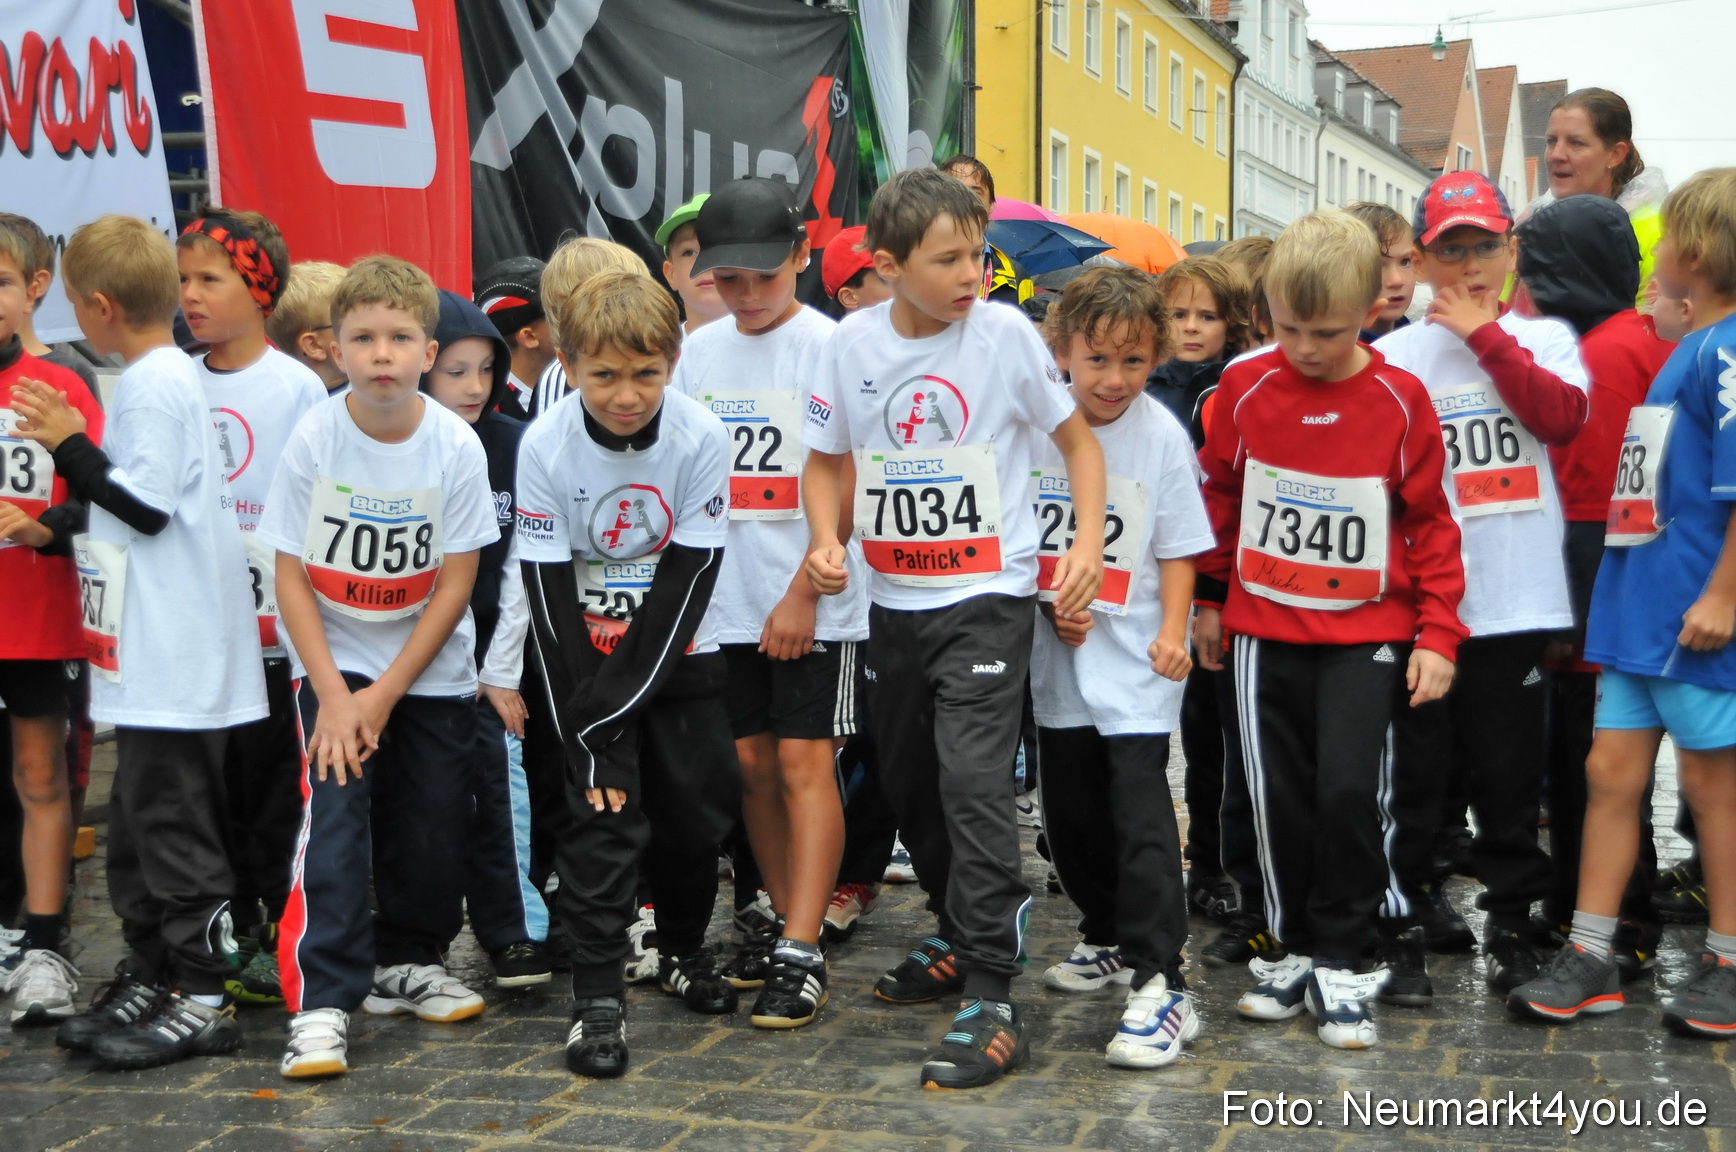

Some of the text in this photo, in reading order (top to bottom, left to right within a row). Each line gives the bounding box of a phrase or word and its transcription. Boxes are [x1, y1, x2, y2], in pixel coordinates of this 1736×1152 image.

[711, 400, 756, 414] BOCK
[1301, 415, 1331, 425] JAKO
[726, 425, 783, 472] 22
[883, 459, 944, 475] BOCK
[1039, 477, 1070, 491] BO
[1276, 478, 1336, 501] BOCK
[350, 495, 414, 516] BOCK
[866, 484, 982, 538] 7034
[987, 524, 995, 534] M
[1257, 499, 1366, 565] 7340
[323, 514, 434, 575] 7058
[893, 547, 962, 571] Patrick
[346, 580, 407, 606] Kilian
[267, 604, 275, 613] M
[1372, 653, 1395, 663] adidas
[971, 664, 1000, 674] JAKO
[1522, 674, 1542, 686] adidas
[1355, 976, 1376, 984] LICO
